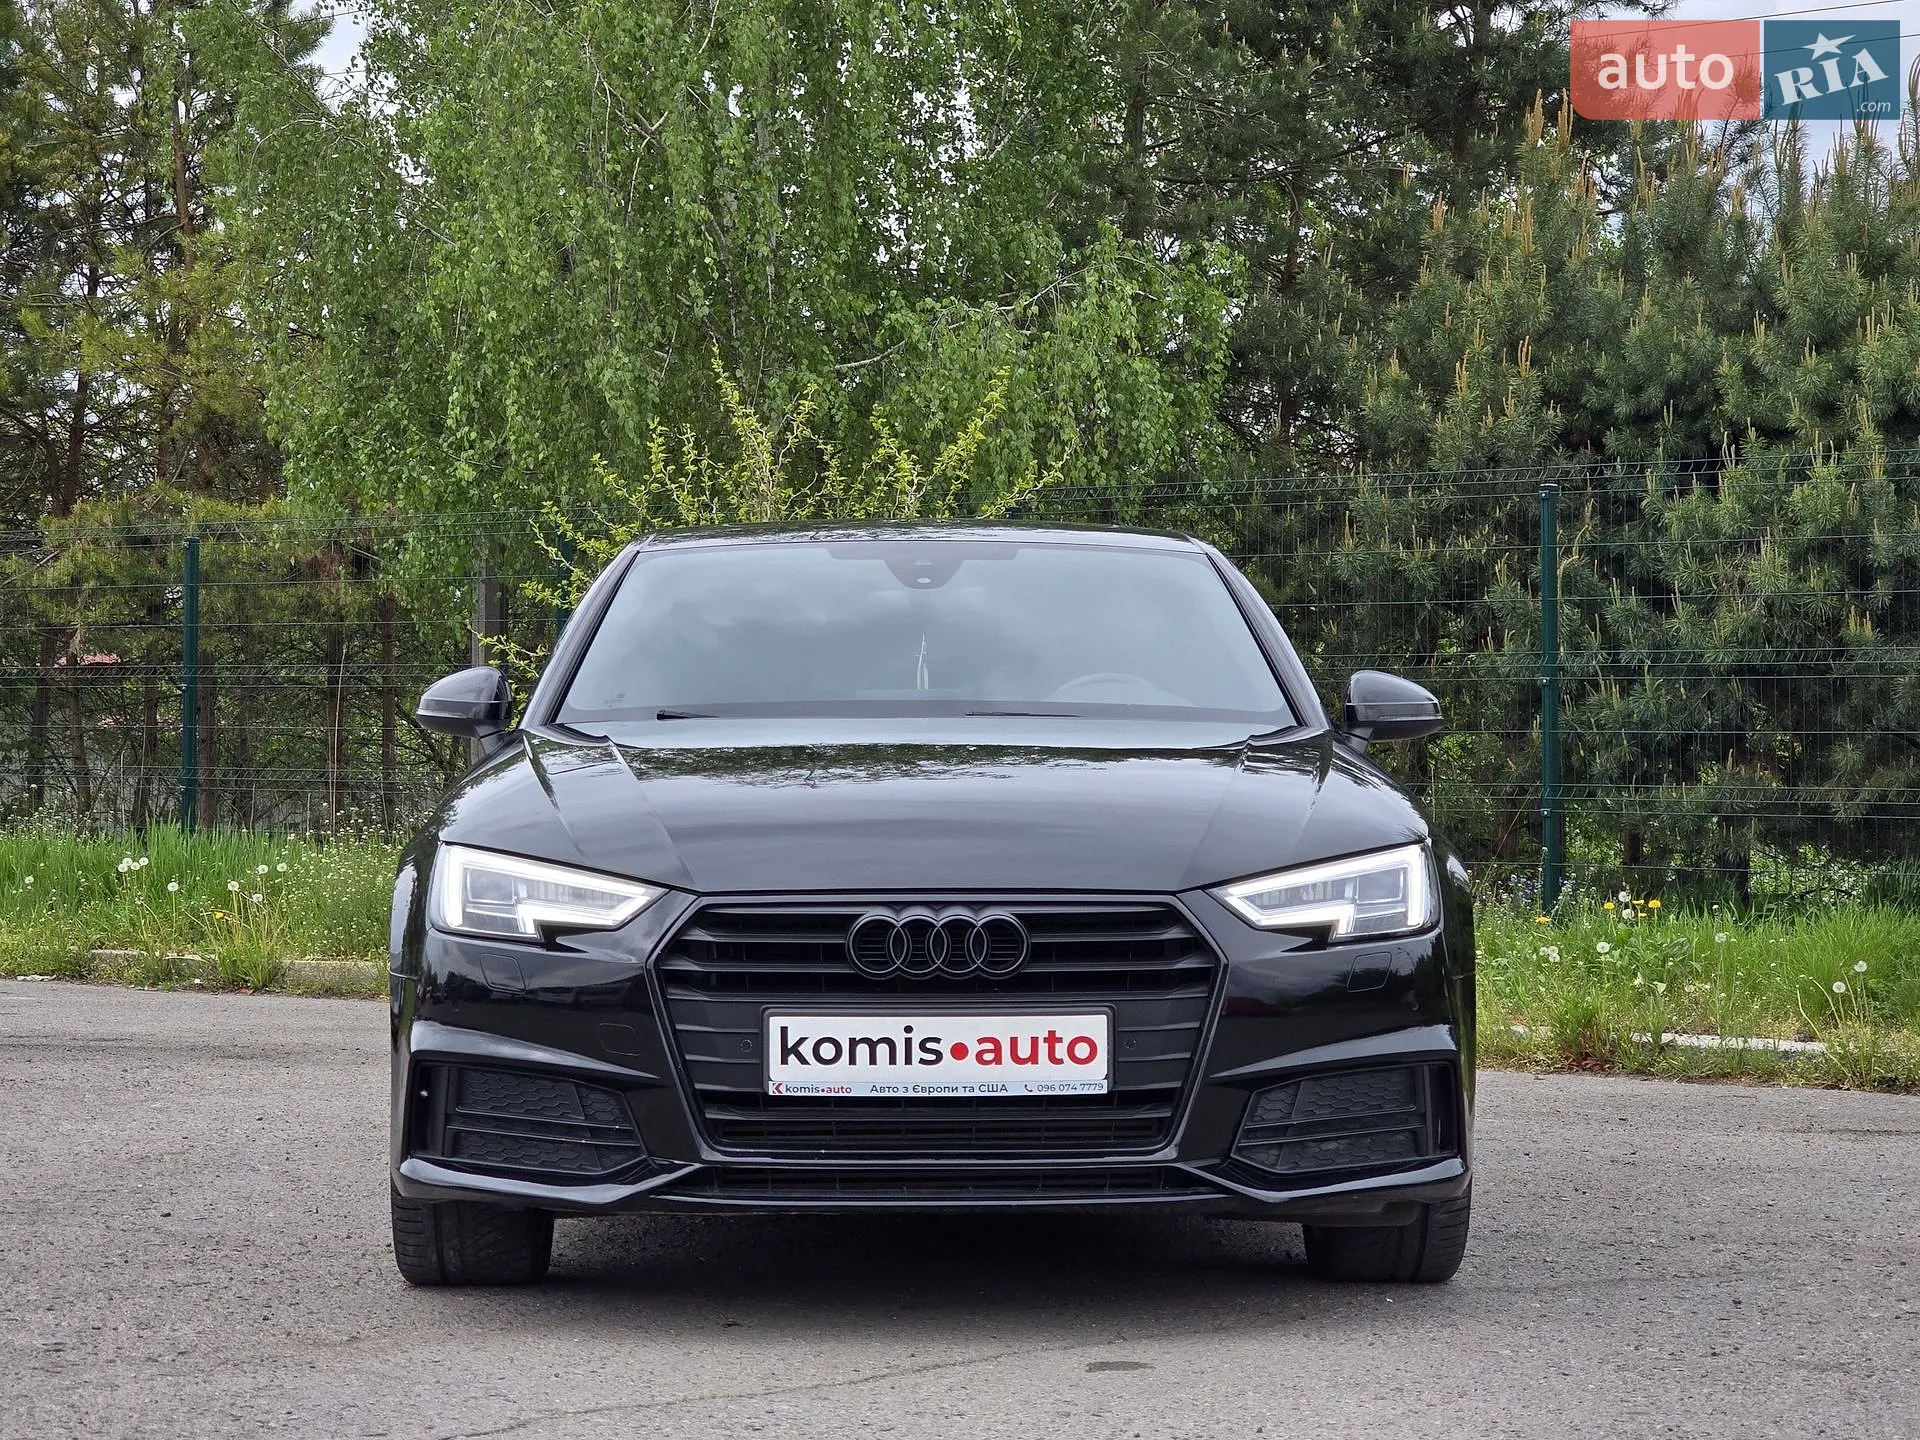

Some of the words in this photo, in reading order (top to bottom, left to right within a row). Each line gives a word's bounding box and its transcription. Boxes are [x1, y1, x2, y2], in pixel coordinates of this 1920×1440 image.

[870, 1084, 899, 1094] Авто
[913, 1084, 958, 1096] Європи
[978, 1084, 1008, 1093] США
[1037, 1084, 1056, 1092] 096
[1058, 1084, 1078, 1092] 074
[1080, 1083, 1104, 1091] 7779
